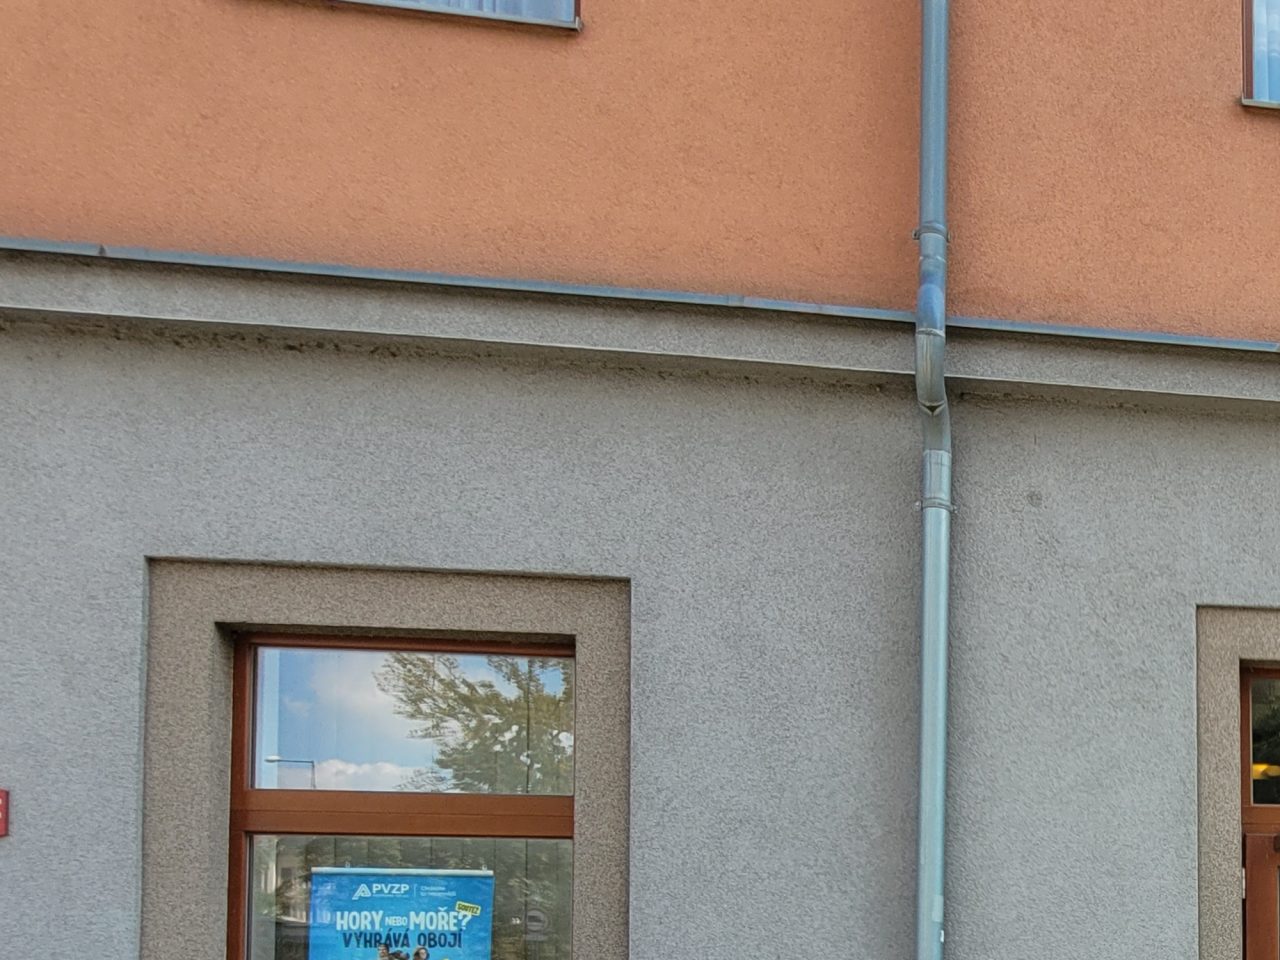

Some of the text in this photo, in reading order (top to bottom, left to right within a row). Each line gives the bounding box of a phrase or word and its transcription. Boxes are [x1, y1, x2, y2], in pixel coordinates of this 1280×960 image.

[372, 883, 409, 895] PVZP
[335, 906, 472, 932] HORY NEBO MOŘE?
[342, 928, 463, 949] VYHRÁVÁ OBOJÍ
